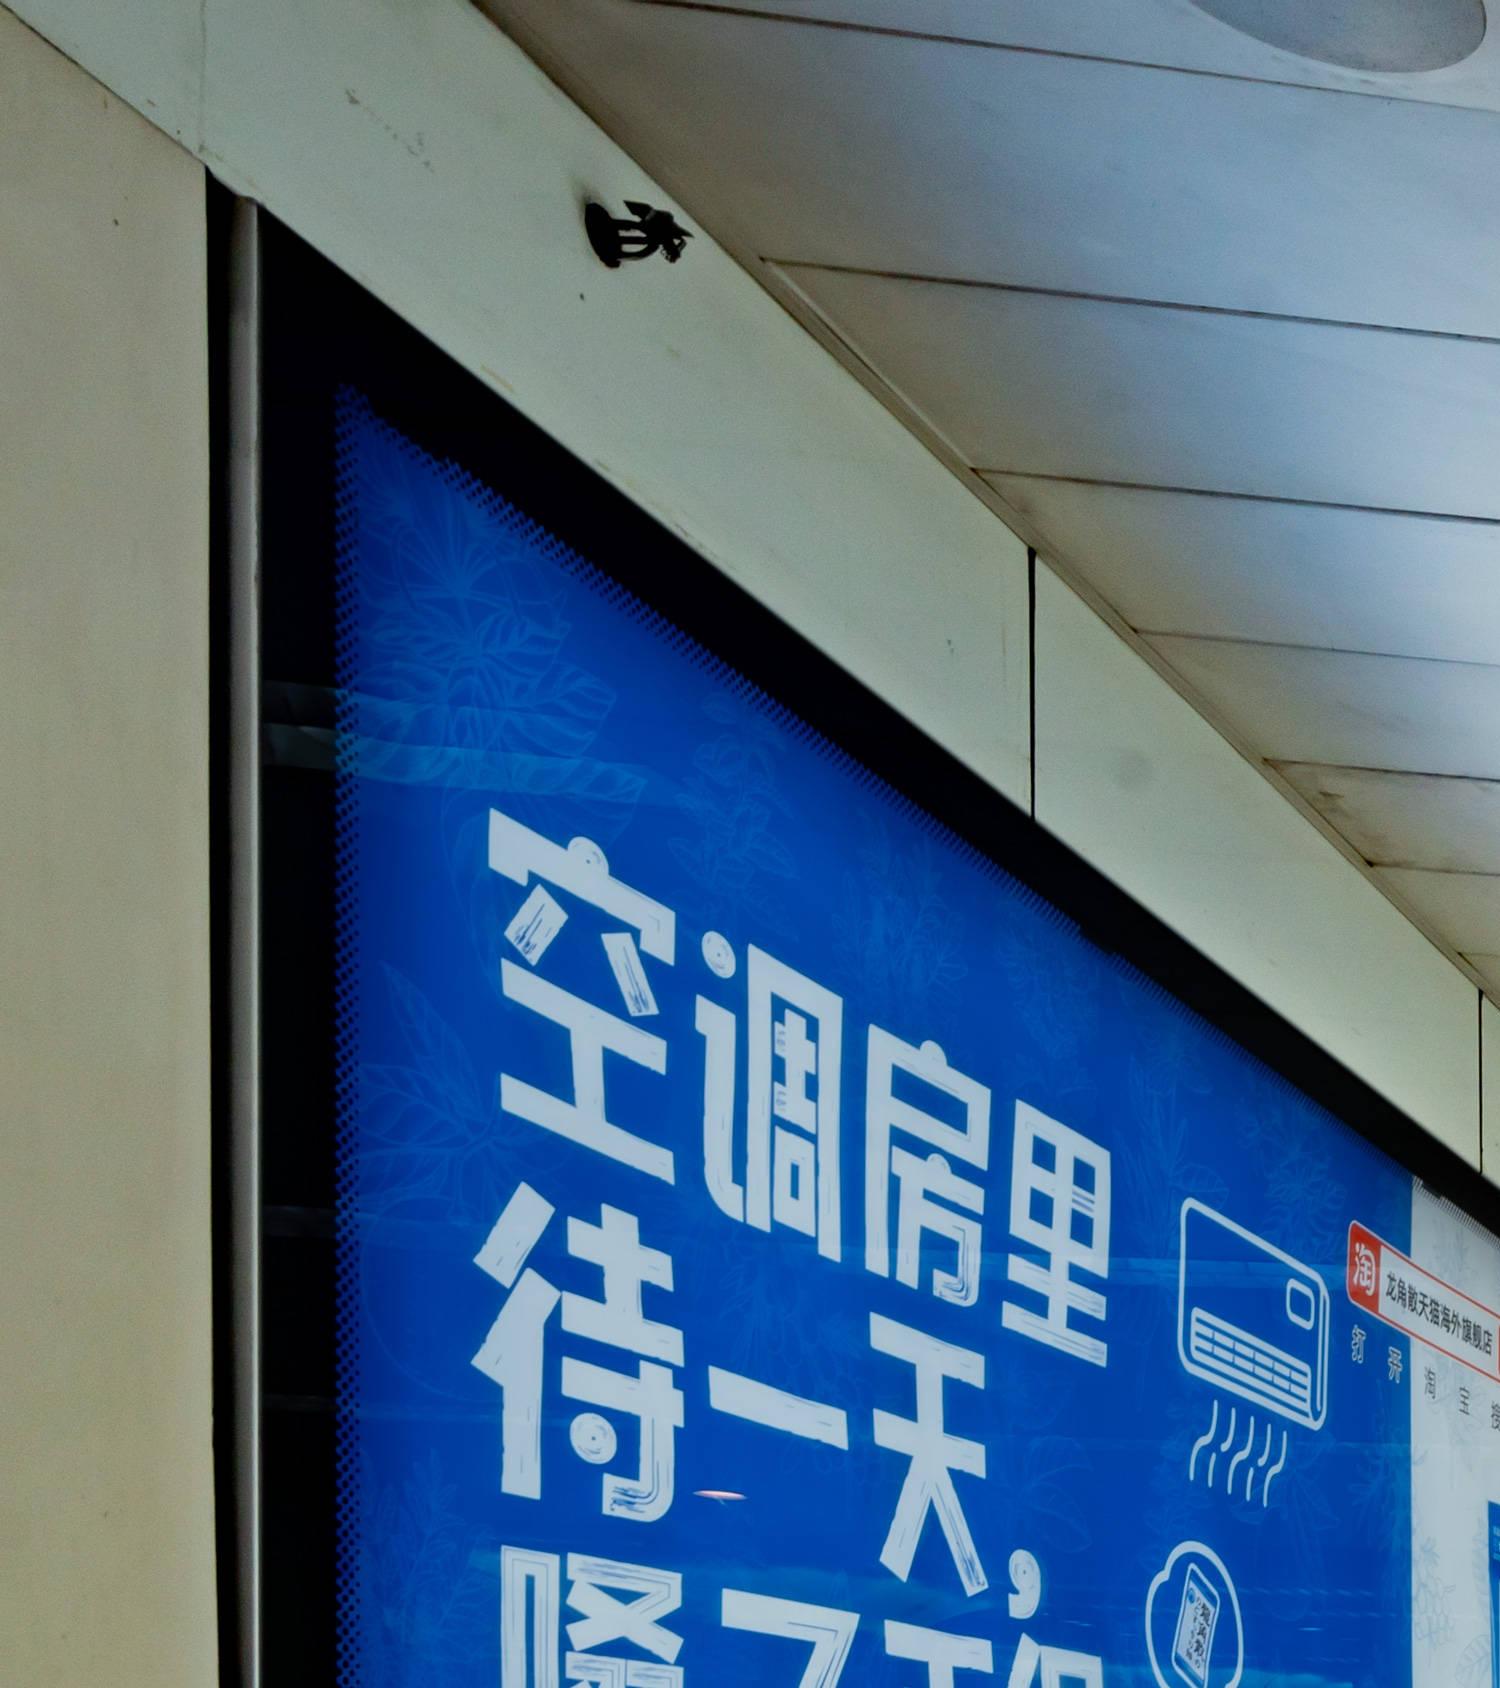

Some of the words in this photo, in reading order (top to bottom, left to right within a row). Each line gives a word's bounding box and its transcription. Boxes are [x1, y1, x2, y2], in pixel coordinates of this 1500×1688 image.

[488, 808, 1111, 1367] 空调房里
[1385, 1270, 1492, 1356] 龙角散天猫海外旗舰店
